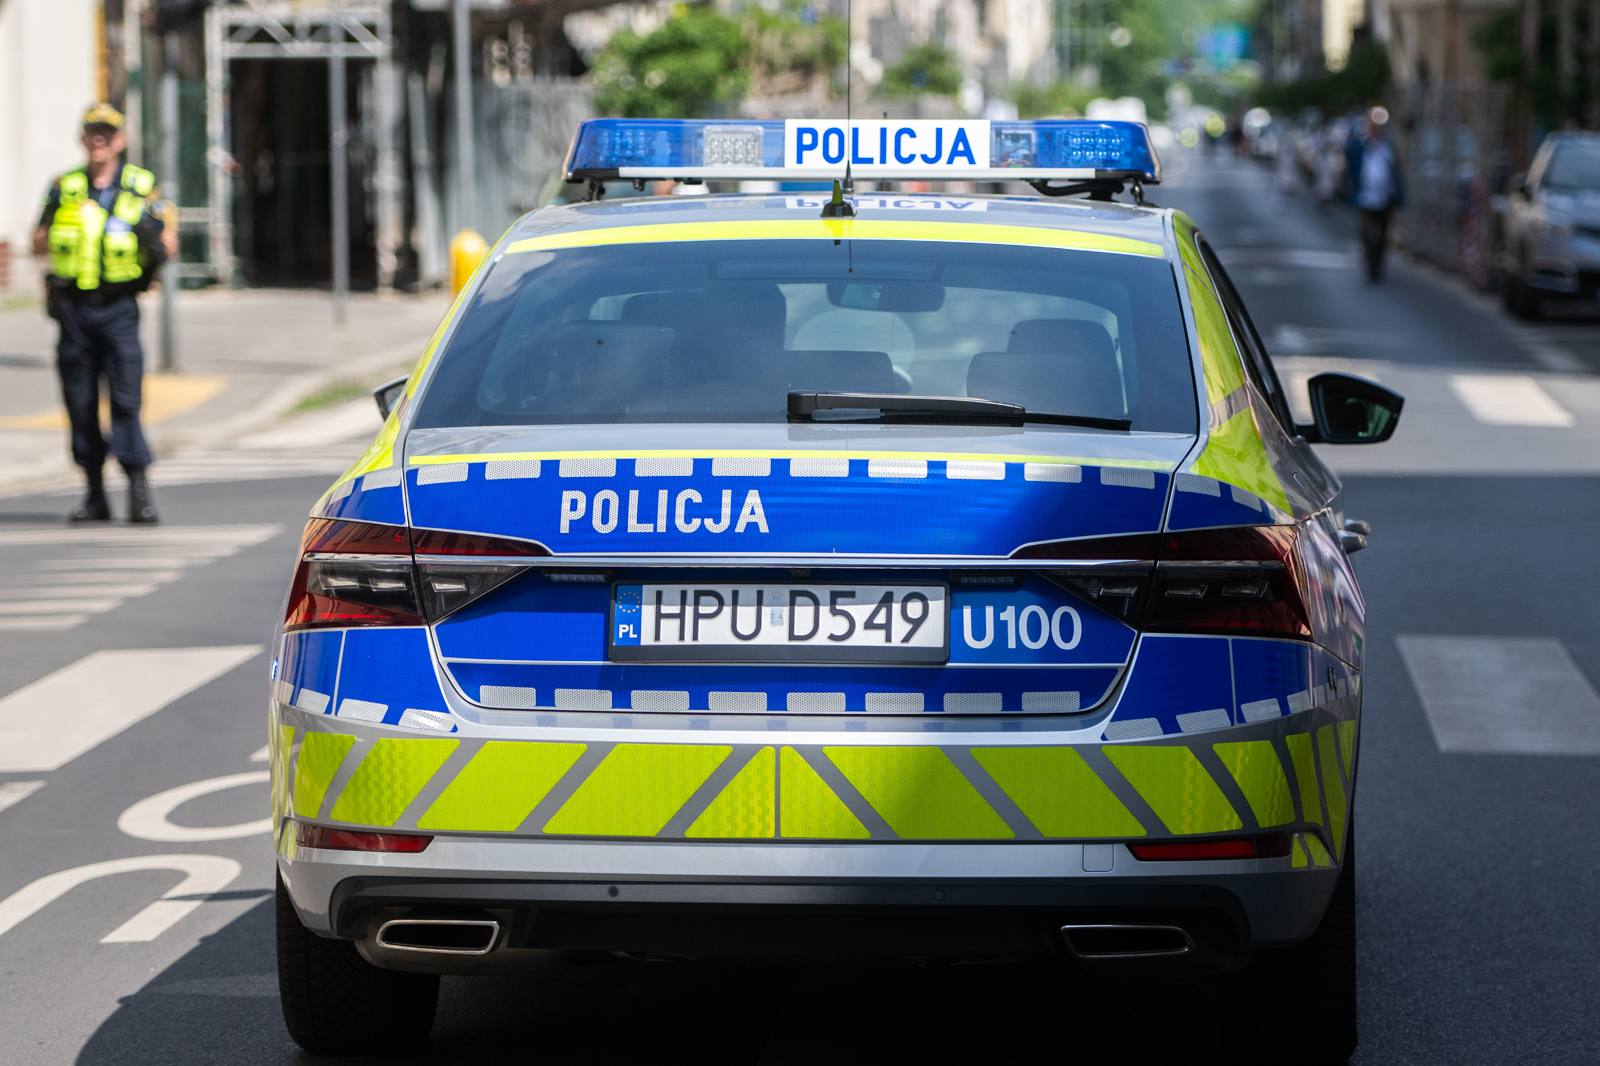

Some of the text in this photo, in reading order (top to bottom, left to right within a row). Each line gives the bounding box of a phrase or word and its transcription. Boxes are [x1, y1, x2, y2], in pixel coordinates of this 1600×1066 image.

[796, 127, 976, 164] POLICJA
[559, 488, 769, 534] POLICJA
[618, 624, 637, 638] PL
[654, 590, 929, 643] HPU D549
[963, 605, 1082, 650] U100
